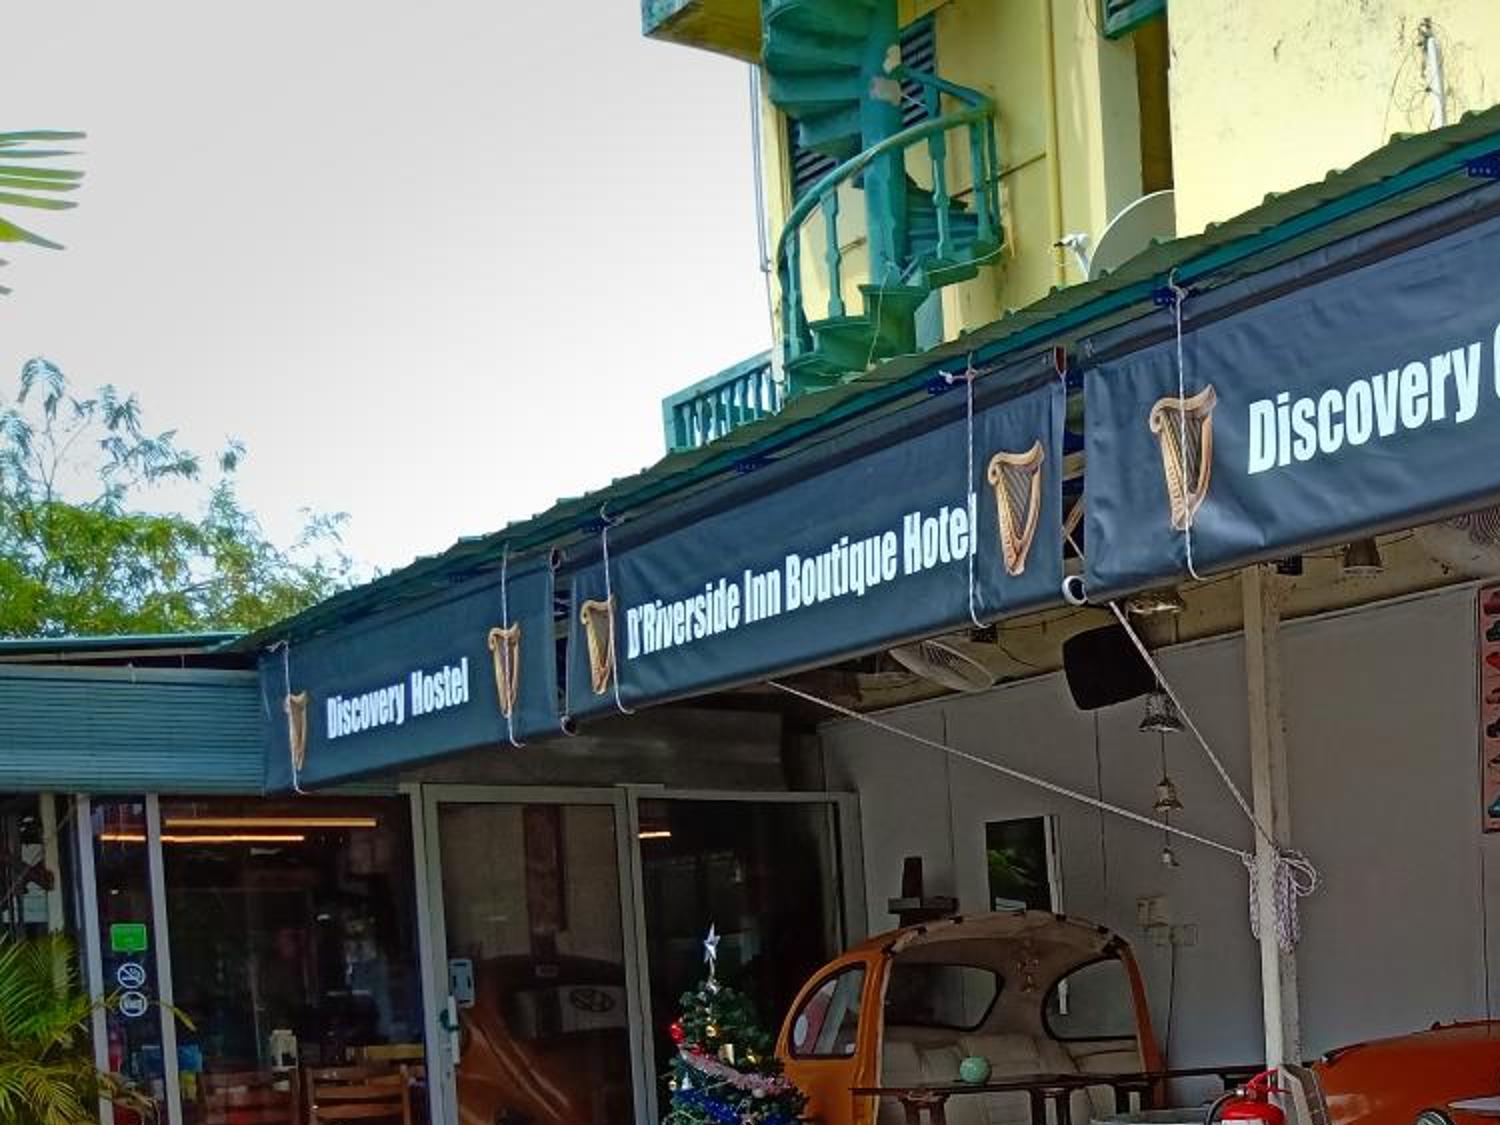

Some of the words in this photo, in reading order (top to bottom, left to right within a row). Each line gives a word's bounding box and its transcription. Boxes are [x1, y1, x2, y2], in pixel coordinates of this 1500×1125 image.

[1247, 342, 1481, 475] Discovery
[626, 579, 740, 660] D'Riverside
[745, 569, 781, 624] Inn
[785, 531, 897, 611] Boutique
[902, 493, 977, 570] Hotel
[326, 680, 406, 739] Discovery
[411, 657, 469, 716] Hostel
